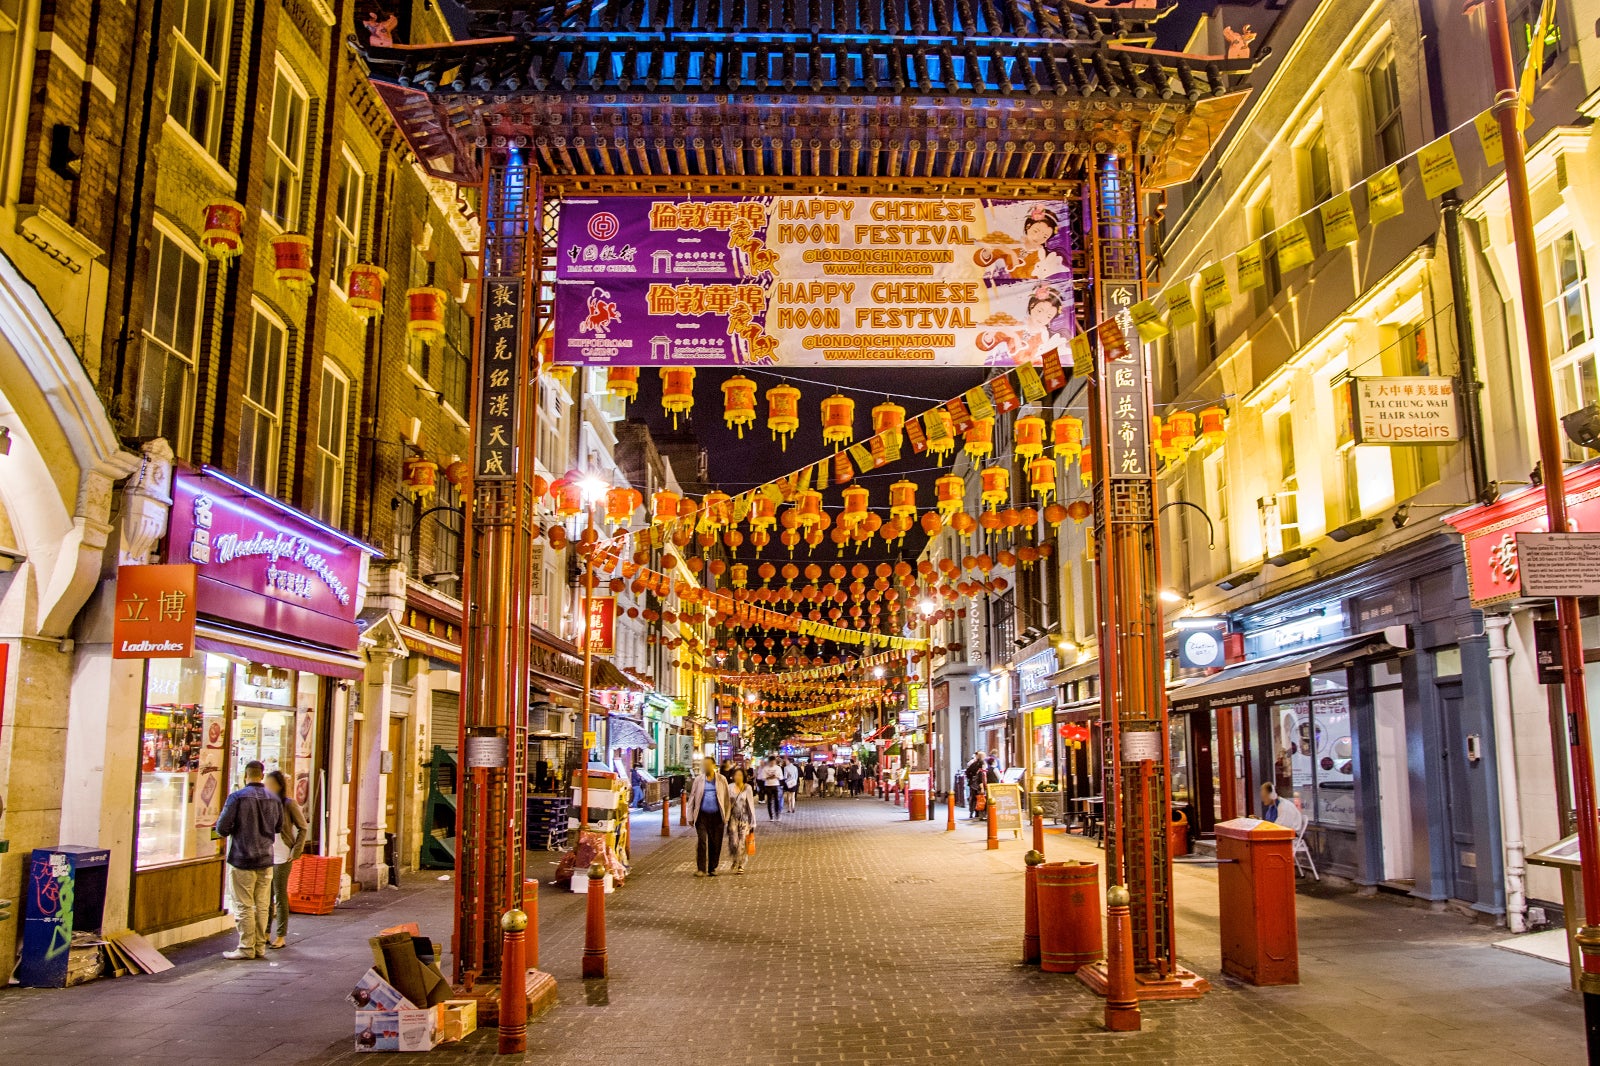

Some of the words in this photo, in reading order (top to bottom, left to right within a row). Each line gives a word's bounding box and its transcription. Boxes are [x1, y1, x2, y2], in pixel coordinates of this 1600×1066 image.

[650, 202, 766, 231] 倫敦華埠
[777, 200, 854, 220] HAPPY
[870, 200, 976, 222] CHINESE
[777, 223, 840, 244] MOON
[855, 225, 975, 245] FESTIVAL
[802, 249, 954, 263] @LONDONCHINATOWN
[823, 263, 933, 275] www.lccauk.com
[646, 284, 766, 316] 倫敦華埠
[777, 283, 855, 303] HAPPY
[870, 283, 979, 304] CHINESE
[777, 307, 840, 329] MOON
[855, 308, 977, 328] FESTIVAL
[802, 334, 955, 348] @LONDONCHINATOWN
[823, 349, 935, 360] www.lccauk.com
[1368, 400, 1385, 408] TAI
[1389, 400, 1423, 408] CHUNG
[1380, 411, 1405, 420] HAIR
[1408, 411, 1440, 420] SALON
[1379, 423, 1449, 440] Upstairs
[213, 530, 295, 563] Wonderful
[120, 590, 187, 622] 立博
[121, 640, 184, 652] Ladbrokes
